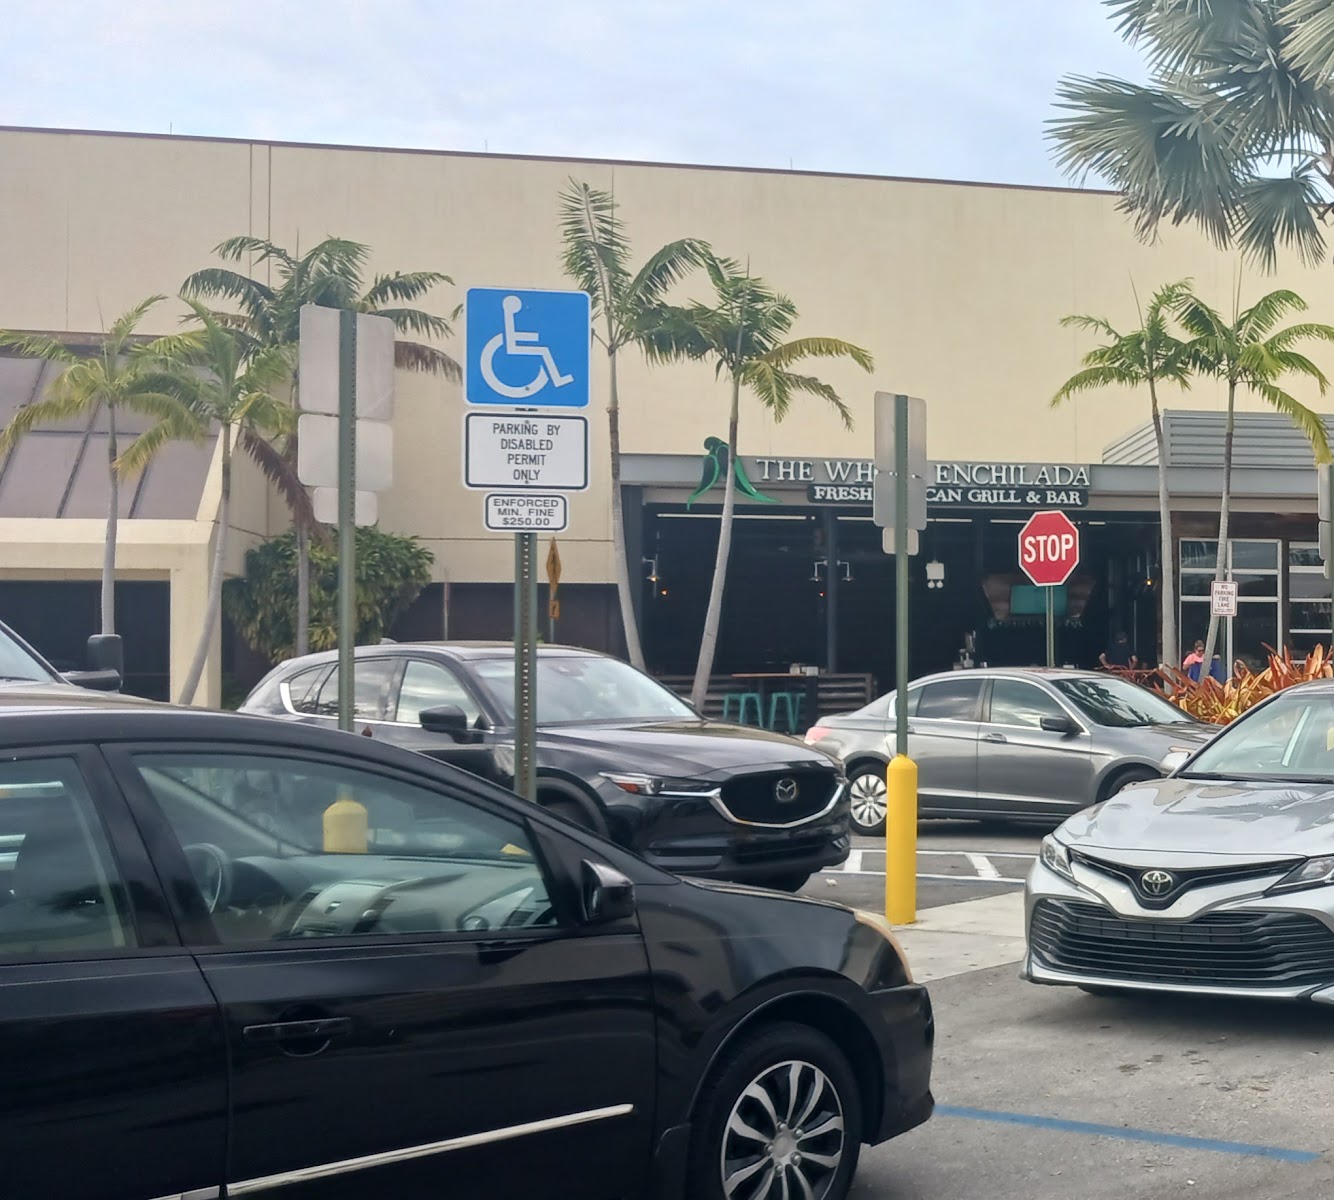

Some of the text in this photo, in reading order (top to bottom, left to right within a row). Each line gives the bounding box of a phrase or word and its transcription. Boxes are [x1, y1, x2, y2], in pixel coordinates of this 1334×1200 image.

[493, 423, 561, 436] PARKING BY
[500, 438, 553, 450] DISABLED
[507, 453, 546, 466] PERMIT
[513, 469, 541, 480] ONLY
[756, 459, 814, 481] THE
[935, 464, 1090, 486] ENCHILADA
[814, 486, 873, 501] FRESH
[967, 489, 1021, 504] GRILL
[1026, 491, 1041, 504] &
[1046, 491, 1082, 505] BAR
[493, 498, 559, 507] ENFORCED
[497, 508, 555, 517] MIN. FINE
[502, 517, 550, 526] $250.00
[1024, 533, 1074, 563] STOP
